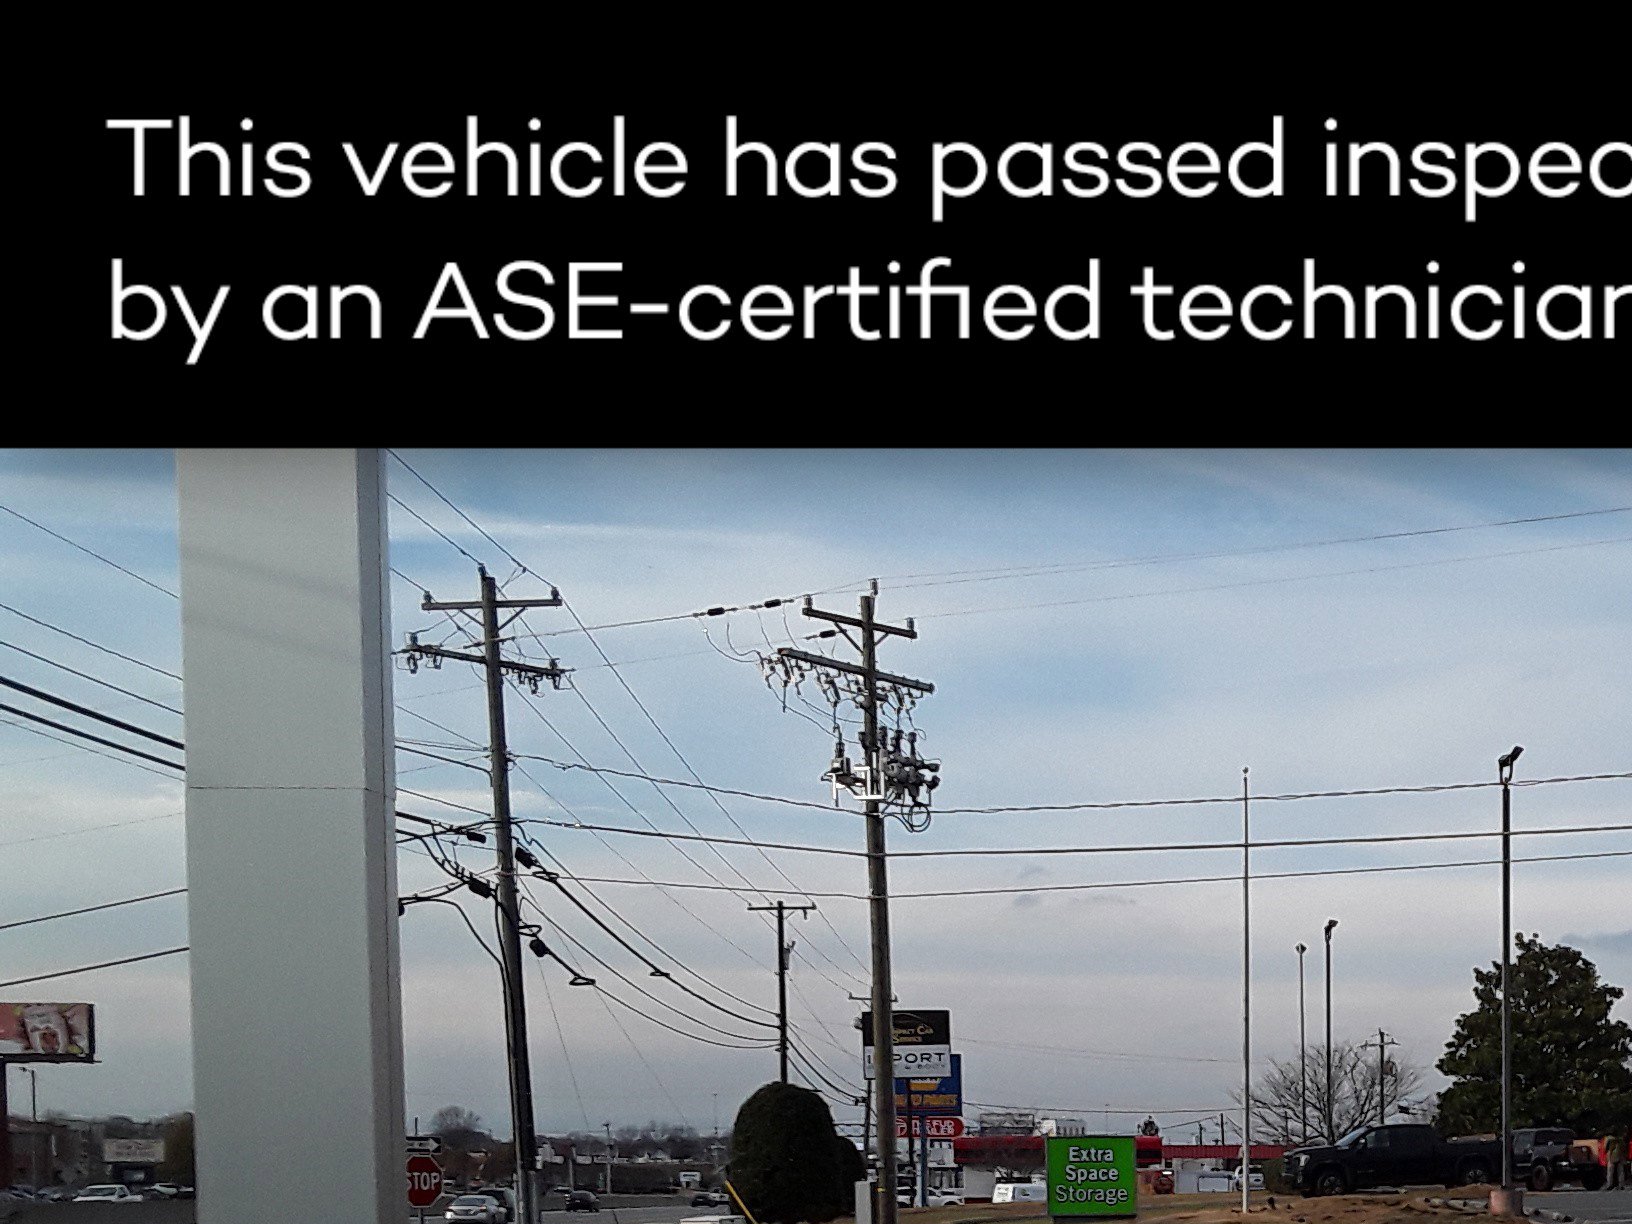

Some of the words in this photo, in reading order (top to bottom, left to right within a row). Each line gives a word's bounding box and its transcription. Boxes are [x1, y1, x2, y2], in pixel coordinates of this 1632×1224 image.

[1068, 1146, 1114, 1162] Extra
[1065, 1164, 1119, 1185] Space
[1055, 1184, 1129, 1205] Storage
